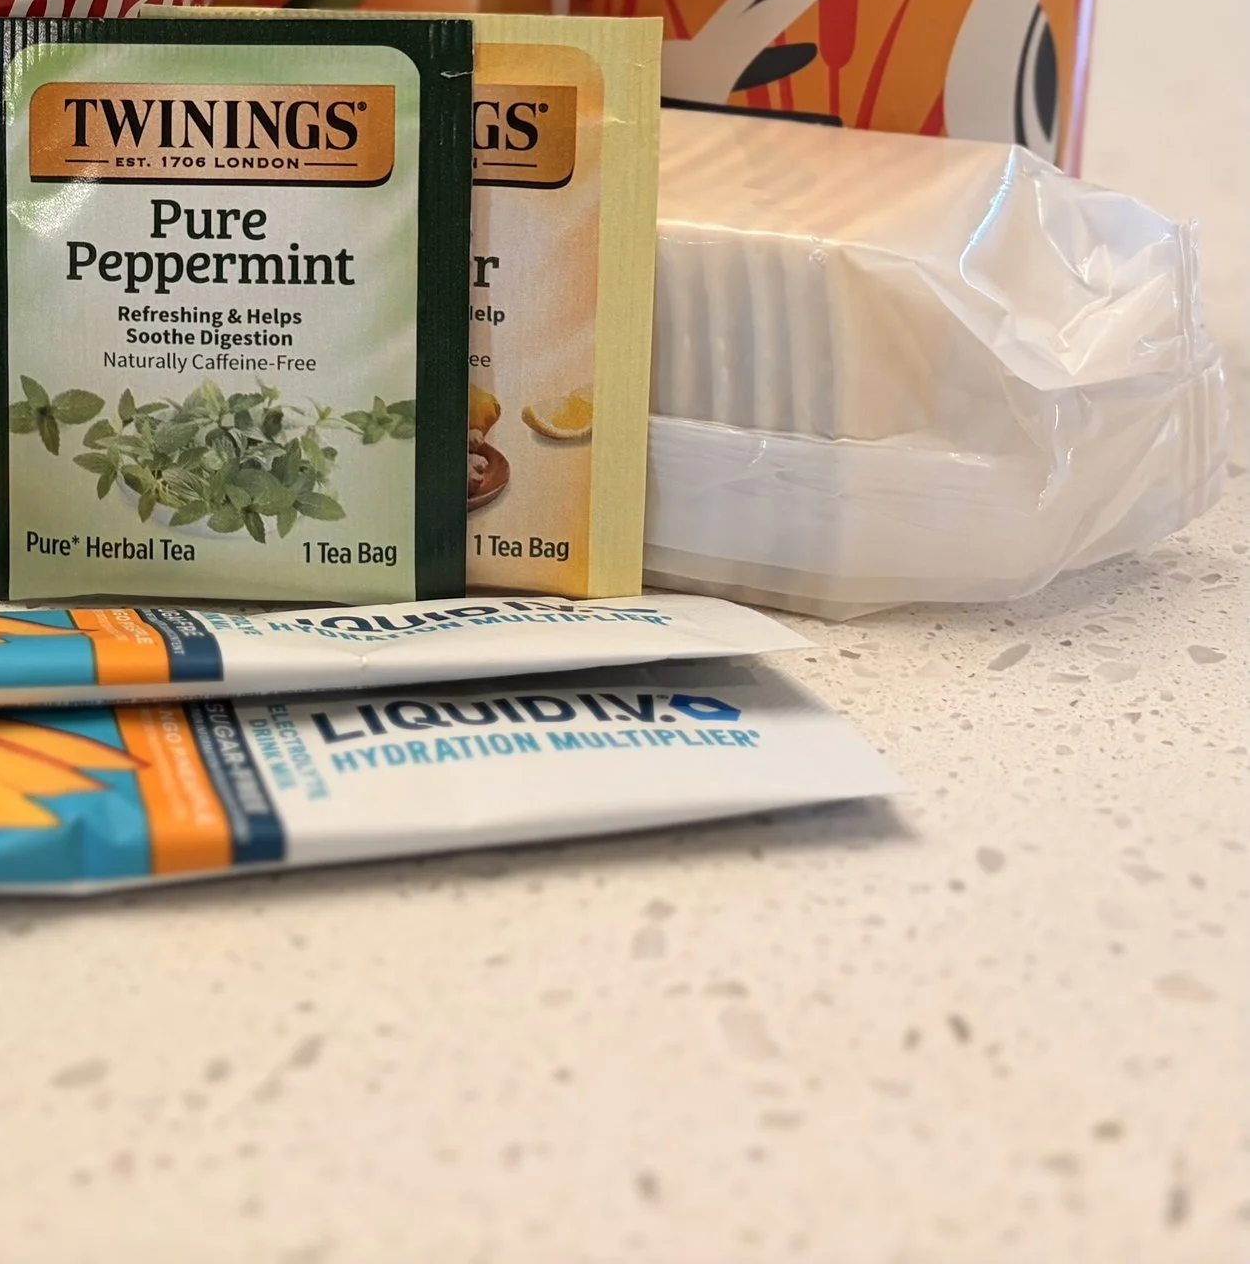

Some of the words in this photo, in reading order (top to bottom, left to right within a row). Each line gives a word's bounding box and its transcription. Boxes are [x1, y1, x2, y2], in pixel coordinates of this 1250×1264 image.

[64, 98, 358, 151] TWININGS
[115, 157, 150, 168] EST.
[161, 156, 206, 168] 1706
[215, 157, 299, 169] LONDON
[150, 199, 267, 240] Pure
[66, 242, 356, 294] Peppermint
[118, 306, 223, 327] Refreshing
[227, 309, 242, 324] &
[247, 308, 302, 327] Helps
[126, 328, 195, 345] Soothe
[200, 329, 293, 350] Digestion
[104, 351, 187, 374] Naturally
[192, 353, 317, 372] Caffeine-Free
[86, 535, 154, 560] Herbal
[160, 539, 195, 561] Tea
[302, 542, 311, 563] 1
[317, 542, 351, 564] Tea
[358, 542, 397, 566] Bag
[473, 534, 482, 556] 1
[488, 535, 522, 557] Tea
[529, 537, 570, 562] Bag
[310, 693, 579, 745] LIQUID
[330, 732, 541, 774] HYDRATION
